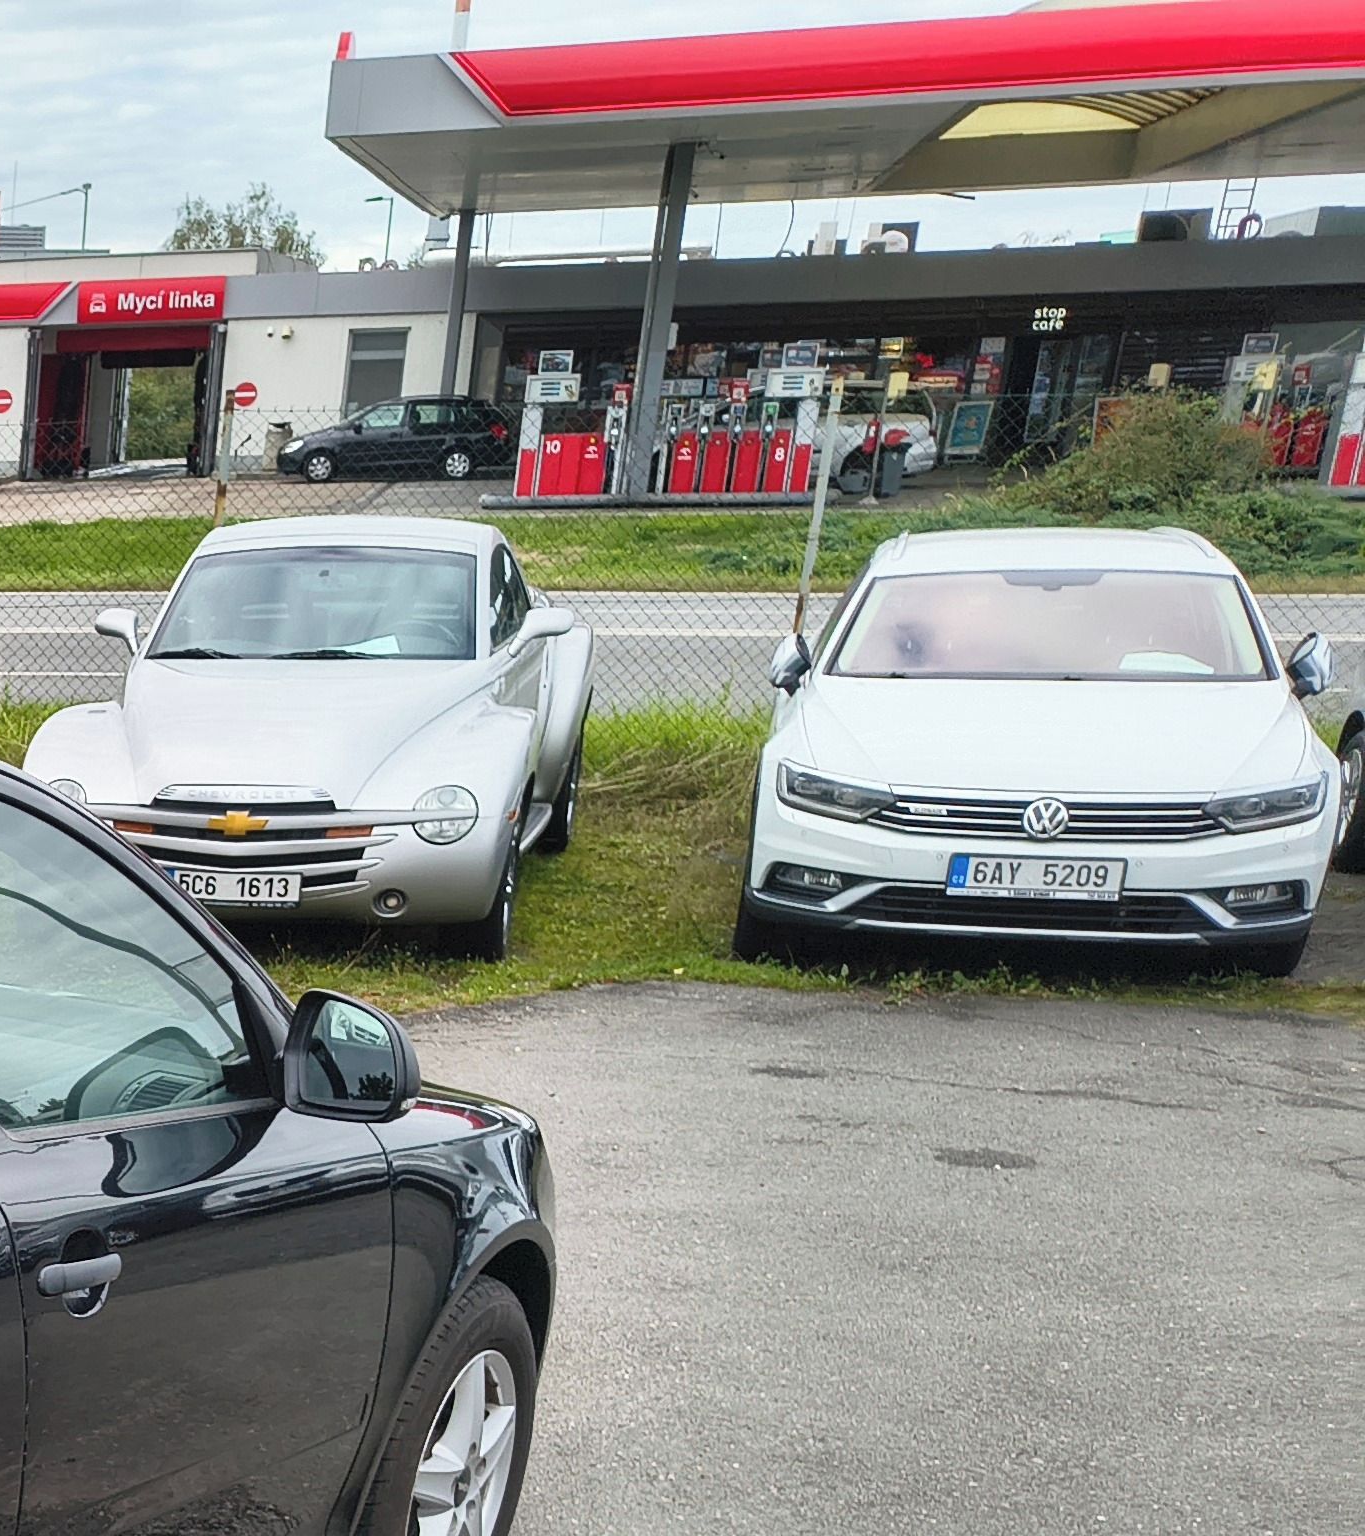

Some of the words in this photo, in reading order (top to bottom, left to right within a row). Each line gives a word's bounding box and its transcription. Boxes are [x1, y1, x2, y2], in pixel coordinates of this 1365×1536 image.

[118, 290, 165, 314] Mycí
[169, 290, 215, 308] linka
[1034, 306, 1066, 320] stop
[545, 441, 561, 454] 10
[774, 447, 785, 462] 8
[187, 788, 298, 800] CHEVROLET
[973, 861, 1022, 885] 6AY
[1043, 863, 1109, 888] 5209
[179, 873, 217, 896] 5C6
[236, 876, 290, 898] 1613
